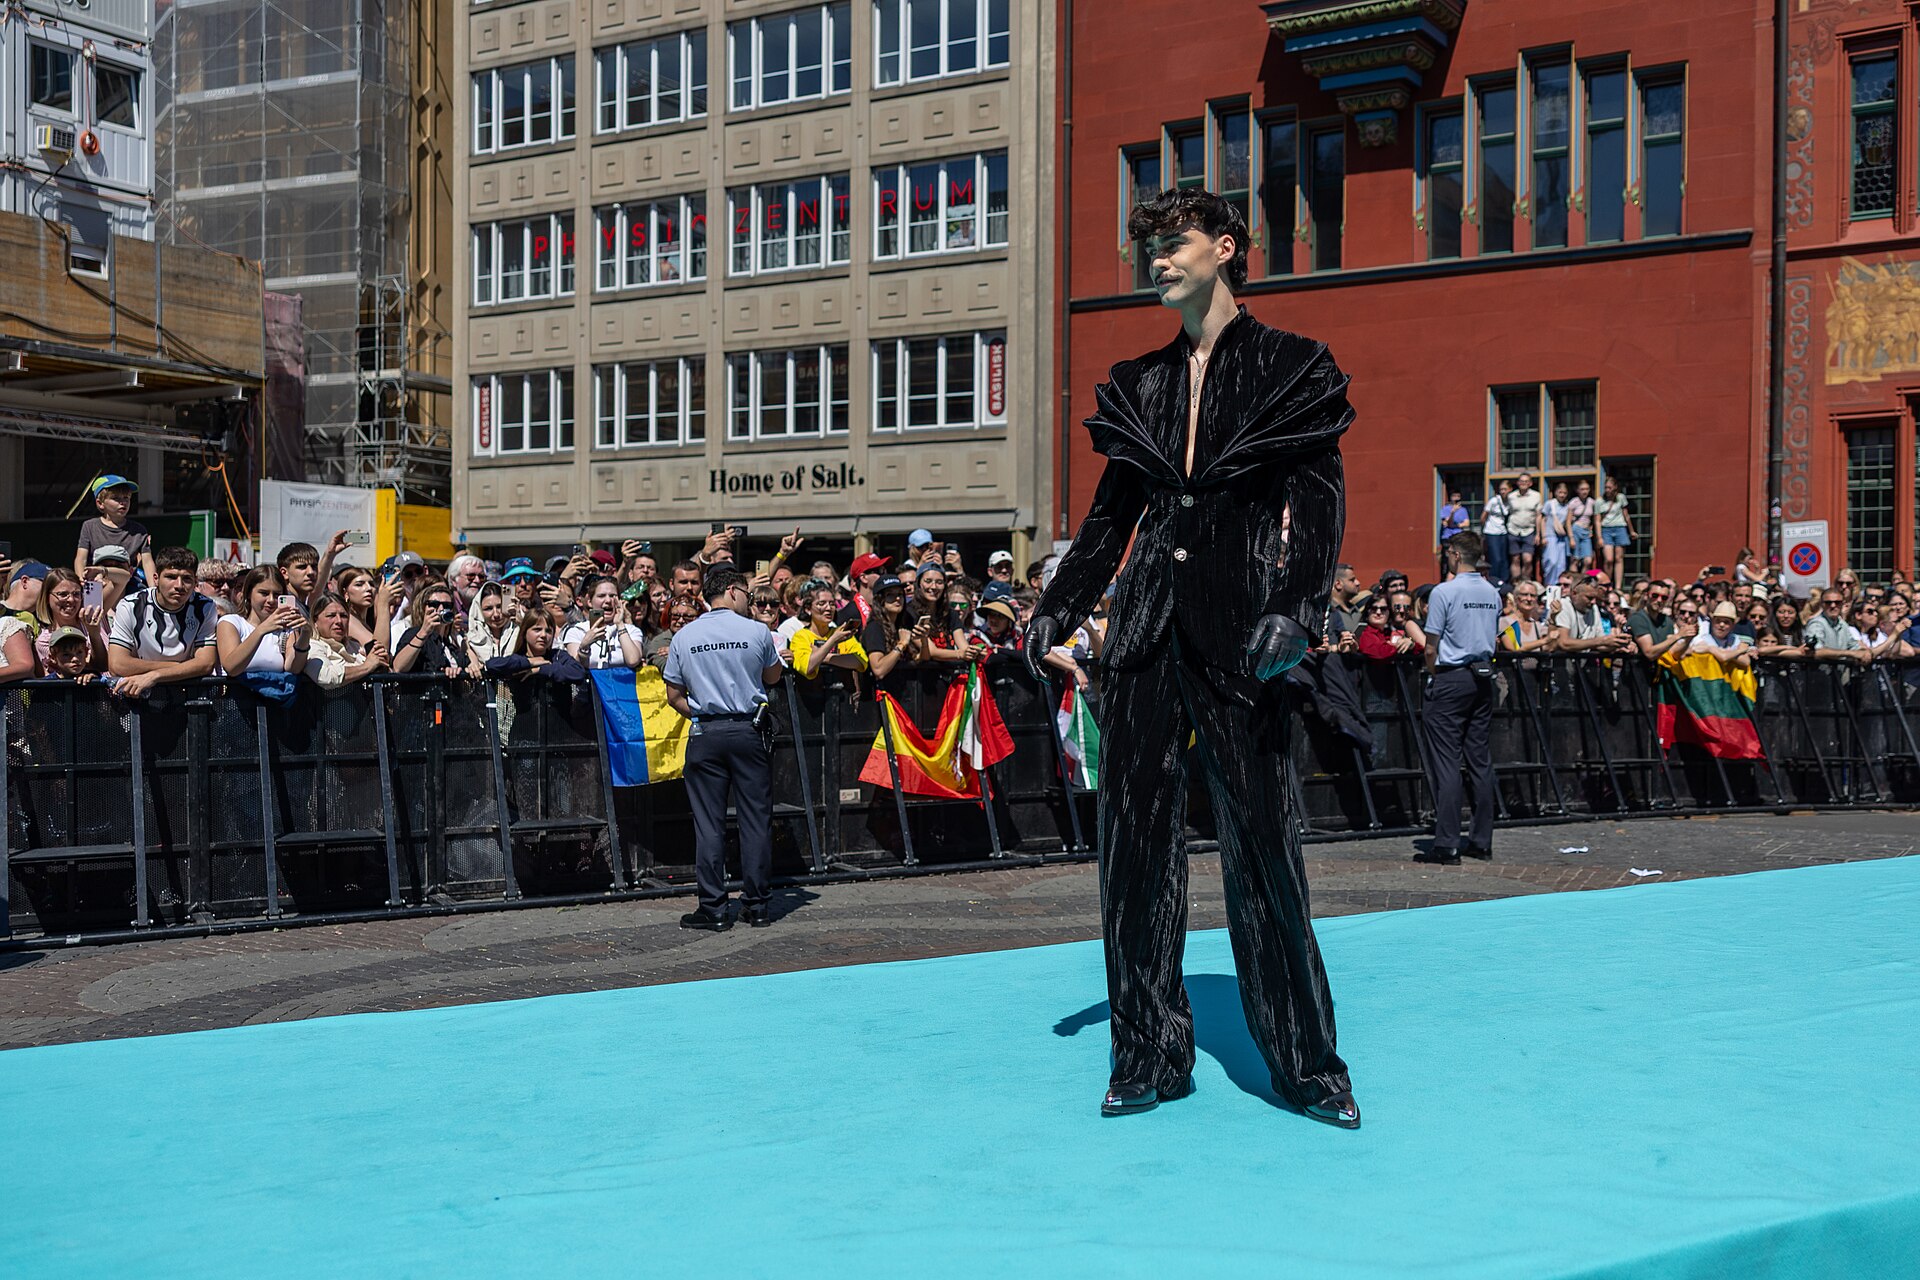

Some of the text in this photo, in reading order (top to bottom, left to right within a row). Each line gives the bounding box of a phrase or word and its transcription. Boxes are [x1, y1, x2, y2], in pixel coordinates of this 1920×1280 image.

[992, 344, 1002, 411] BASILISK
[709, 462, 865, 494] Home of Salt.
[690, 641, 749, 654] SECURITAS
